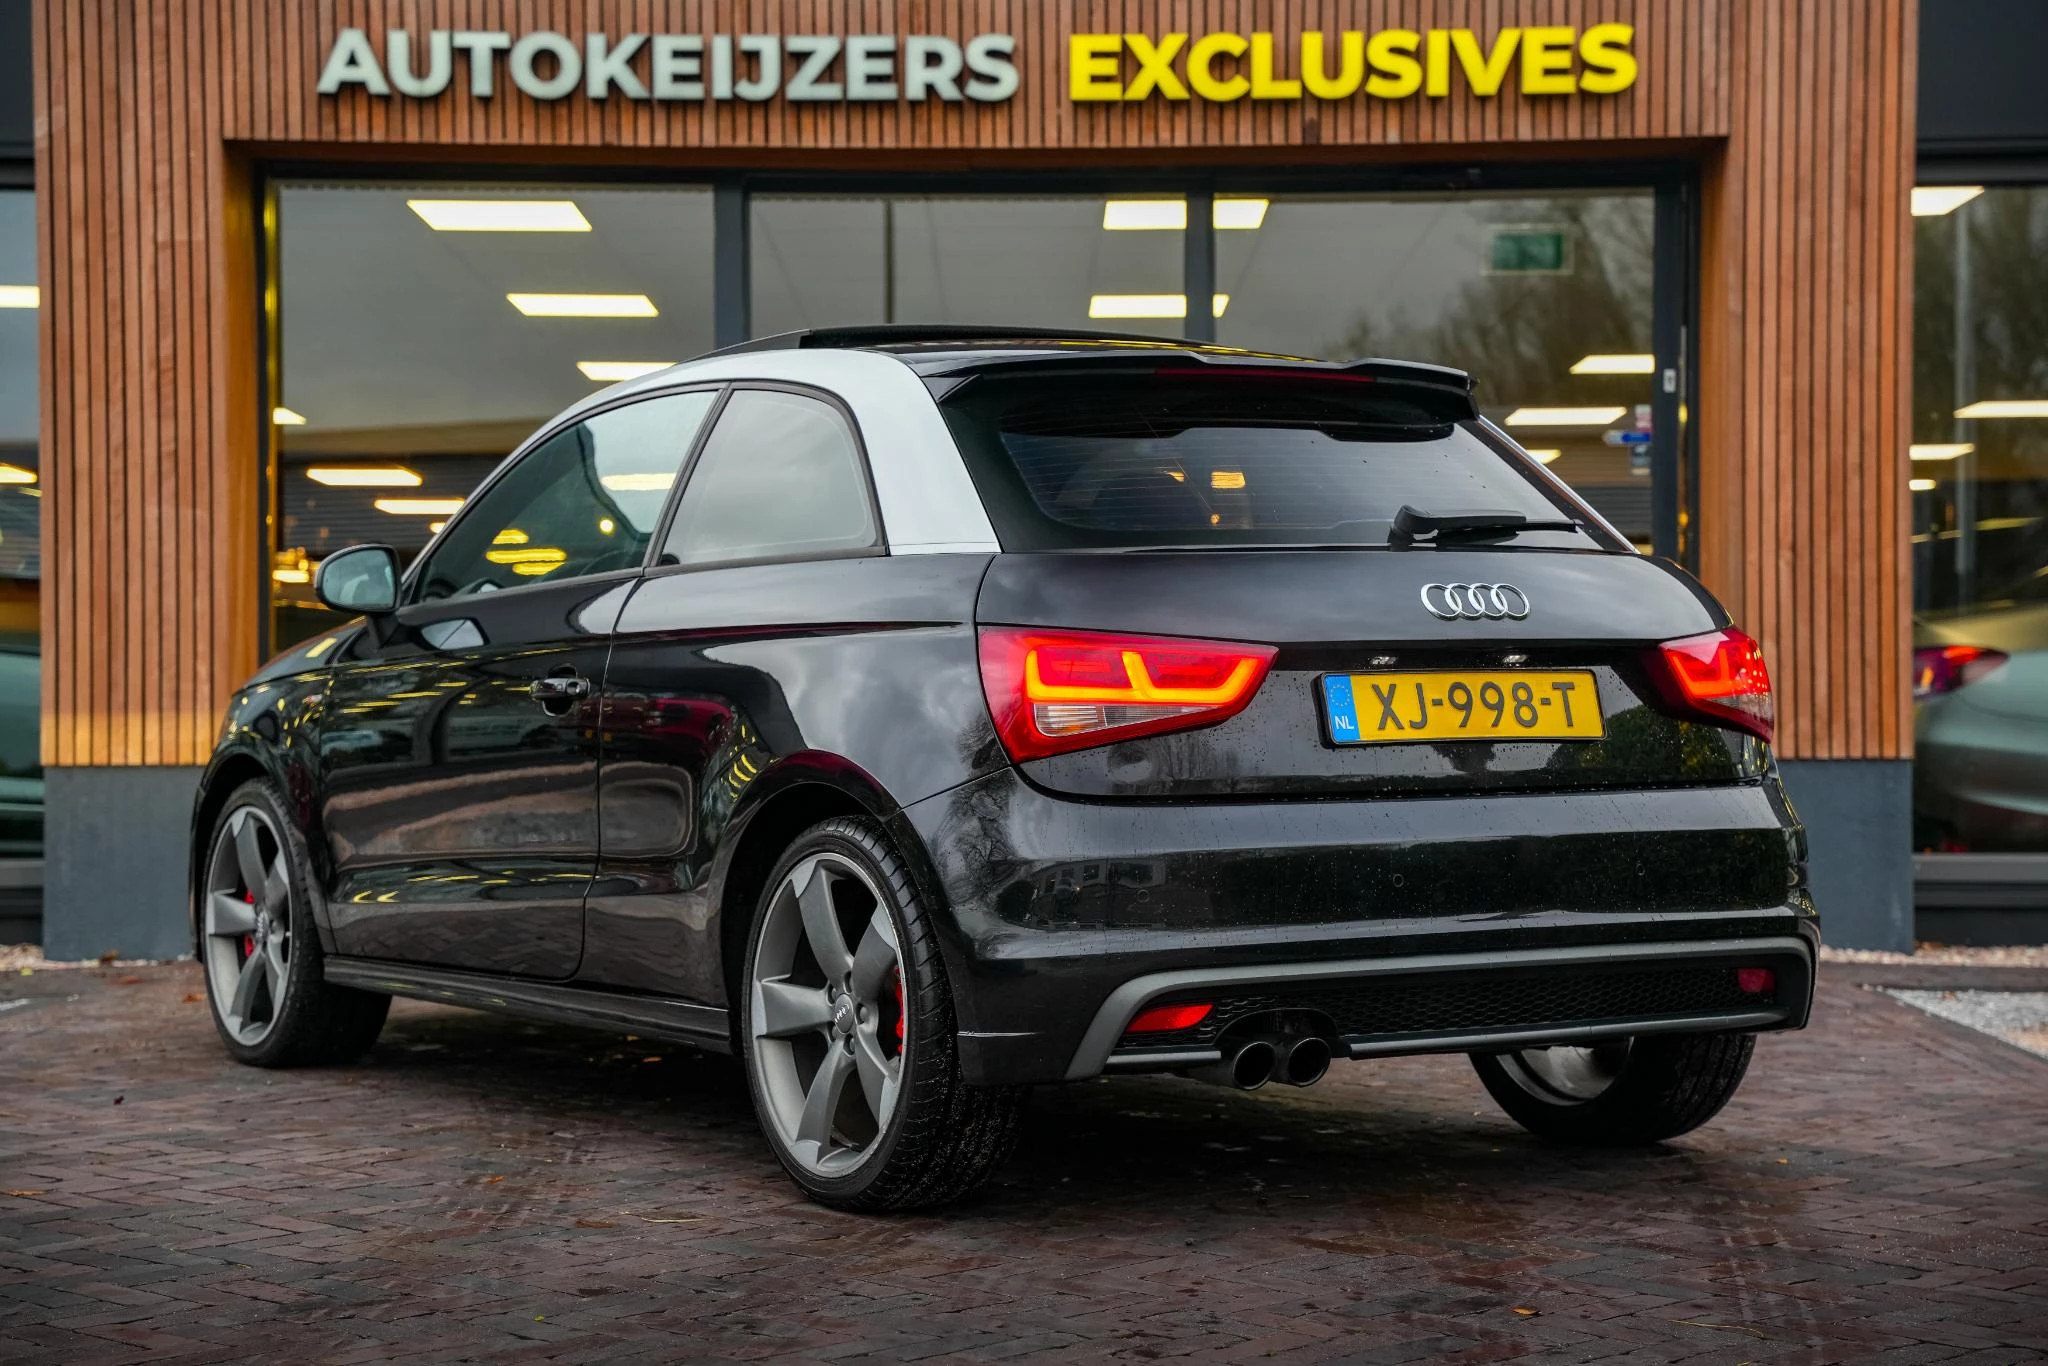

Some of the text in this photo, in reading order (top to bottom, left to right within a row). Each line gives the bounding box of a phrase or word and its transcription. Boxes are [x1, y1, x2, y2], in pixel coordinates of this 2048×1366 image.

[316, 22, 1638, 102] AUTOKEIJZERS EXCLUSIVES
[1334, 715, 1355, 730] NL
[1371, 681, 1576, 730] XJ-998-T
